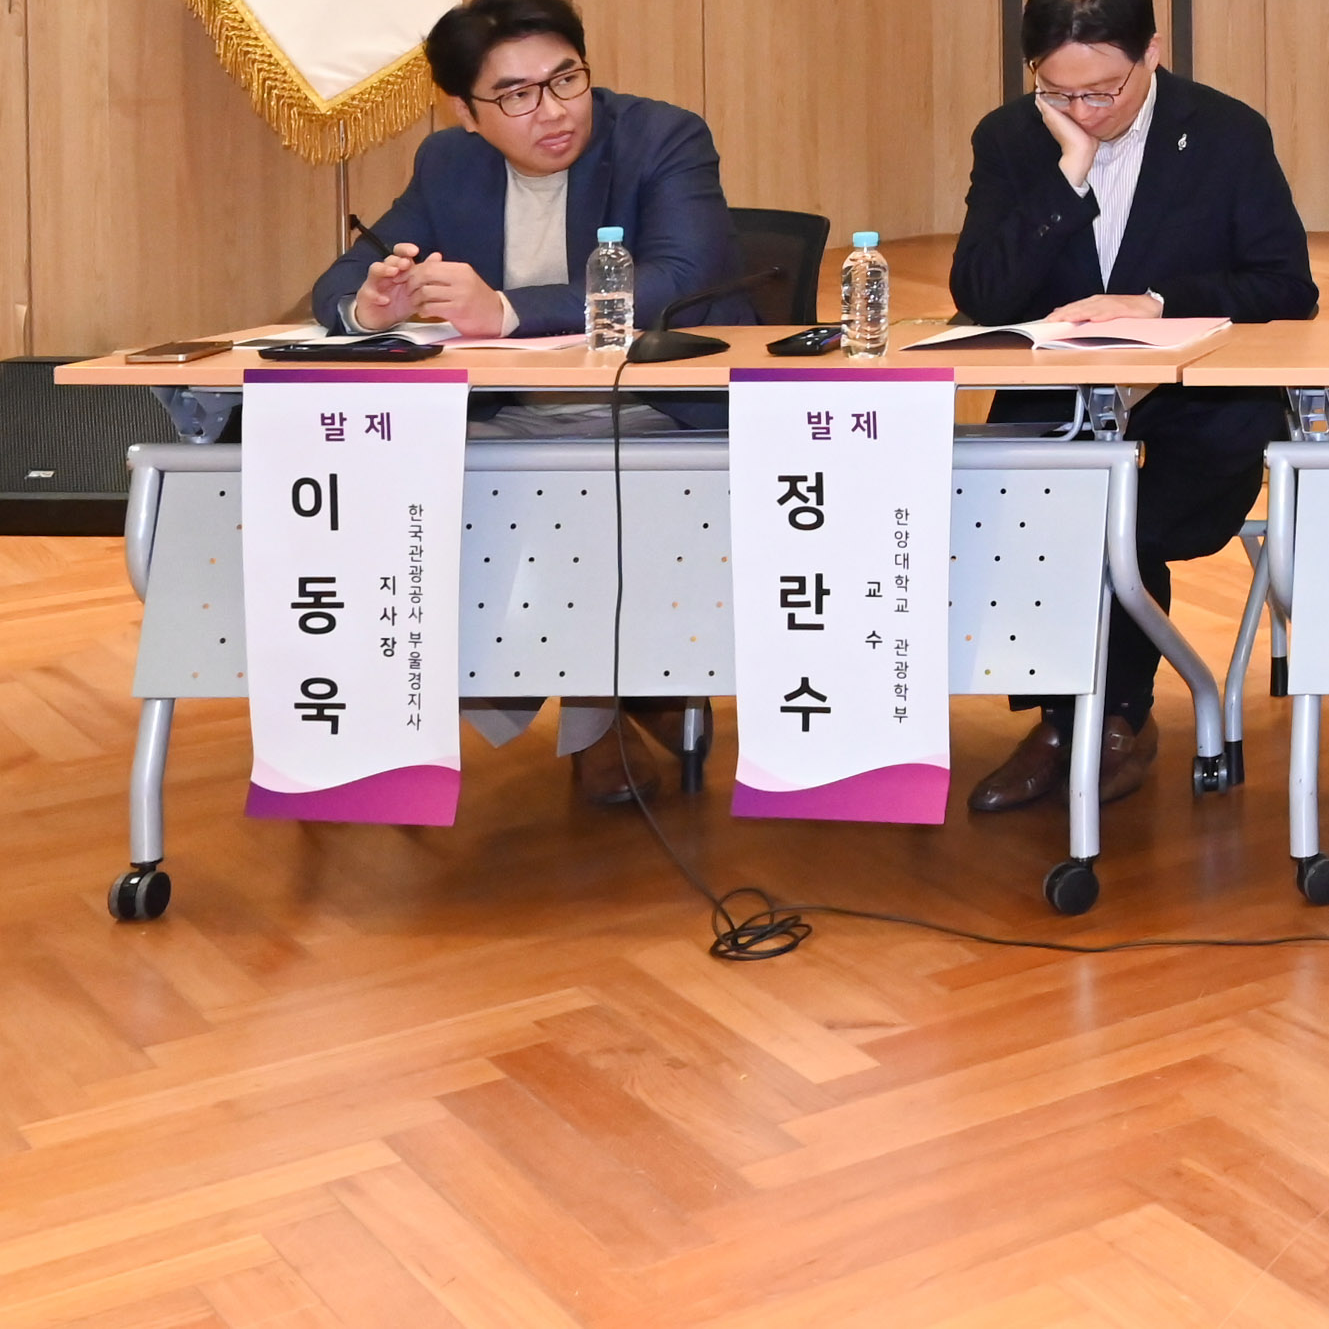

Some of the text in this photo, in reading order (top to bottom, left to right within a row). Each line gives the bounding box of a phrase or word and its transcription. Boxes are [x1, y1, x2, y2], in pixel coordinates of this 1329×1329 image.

[320, 411, 392, 442] 발제
[806, 410, 878, 441] 발제
[290, 472, 347, 736] 이동욱
[379, 575, 398, 658] 지사장
[405, 503, 425, 732] 한국관광공사 부울경지사
[776, 471, 832, 733] 정란수
[864, 581, 883, 650] 교수
[892, 507, 911, 724] 한양대학교 관광학부
